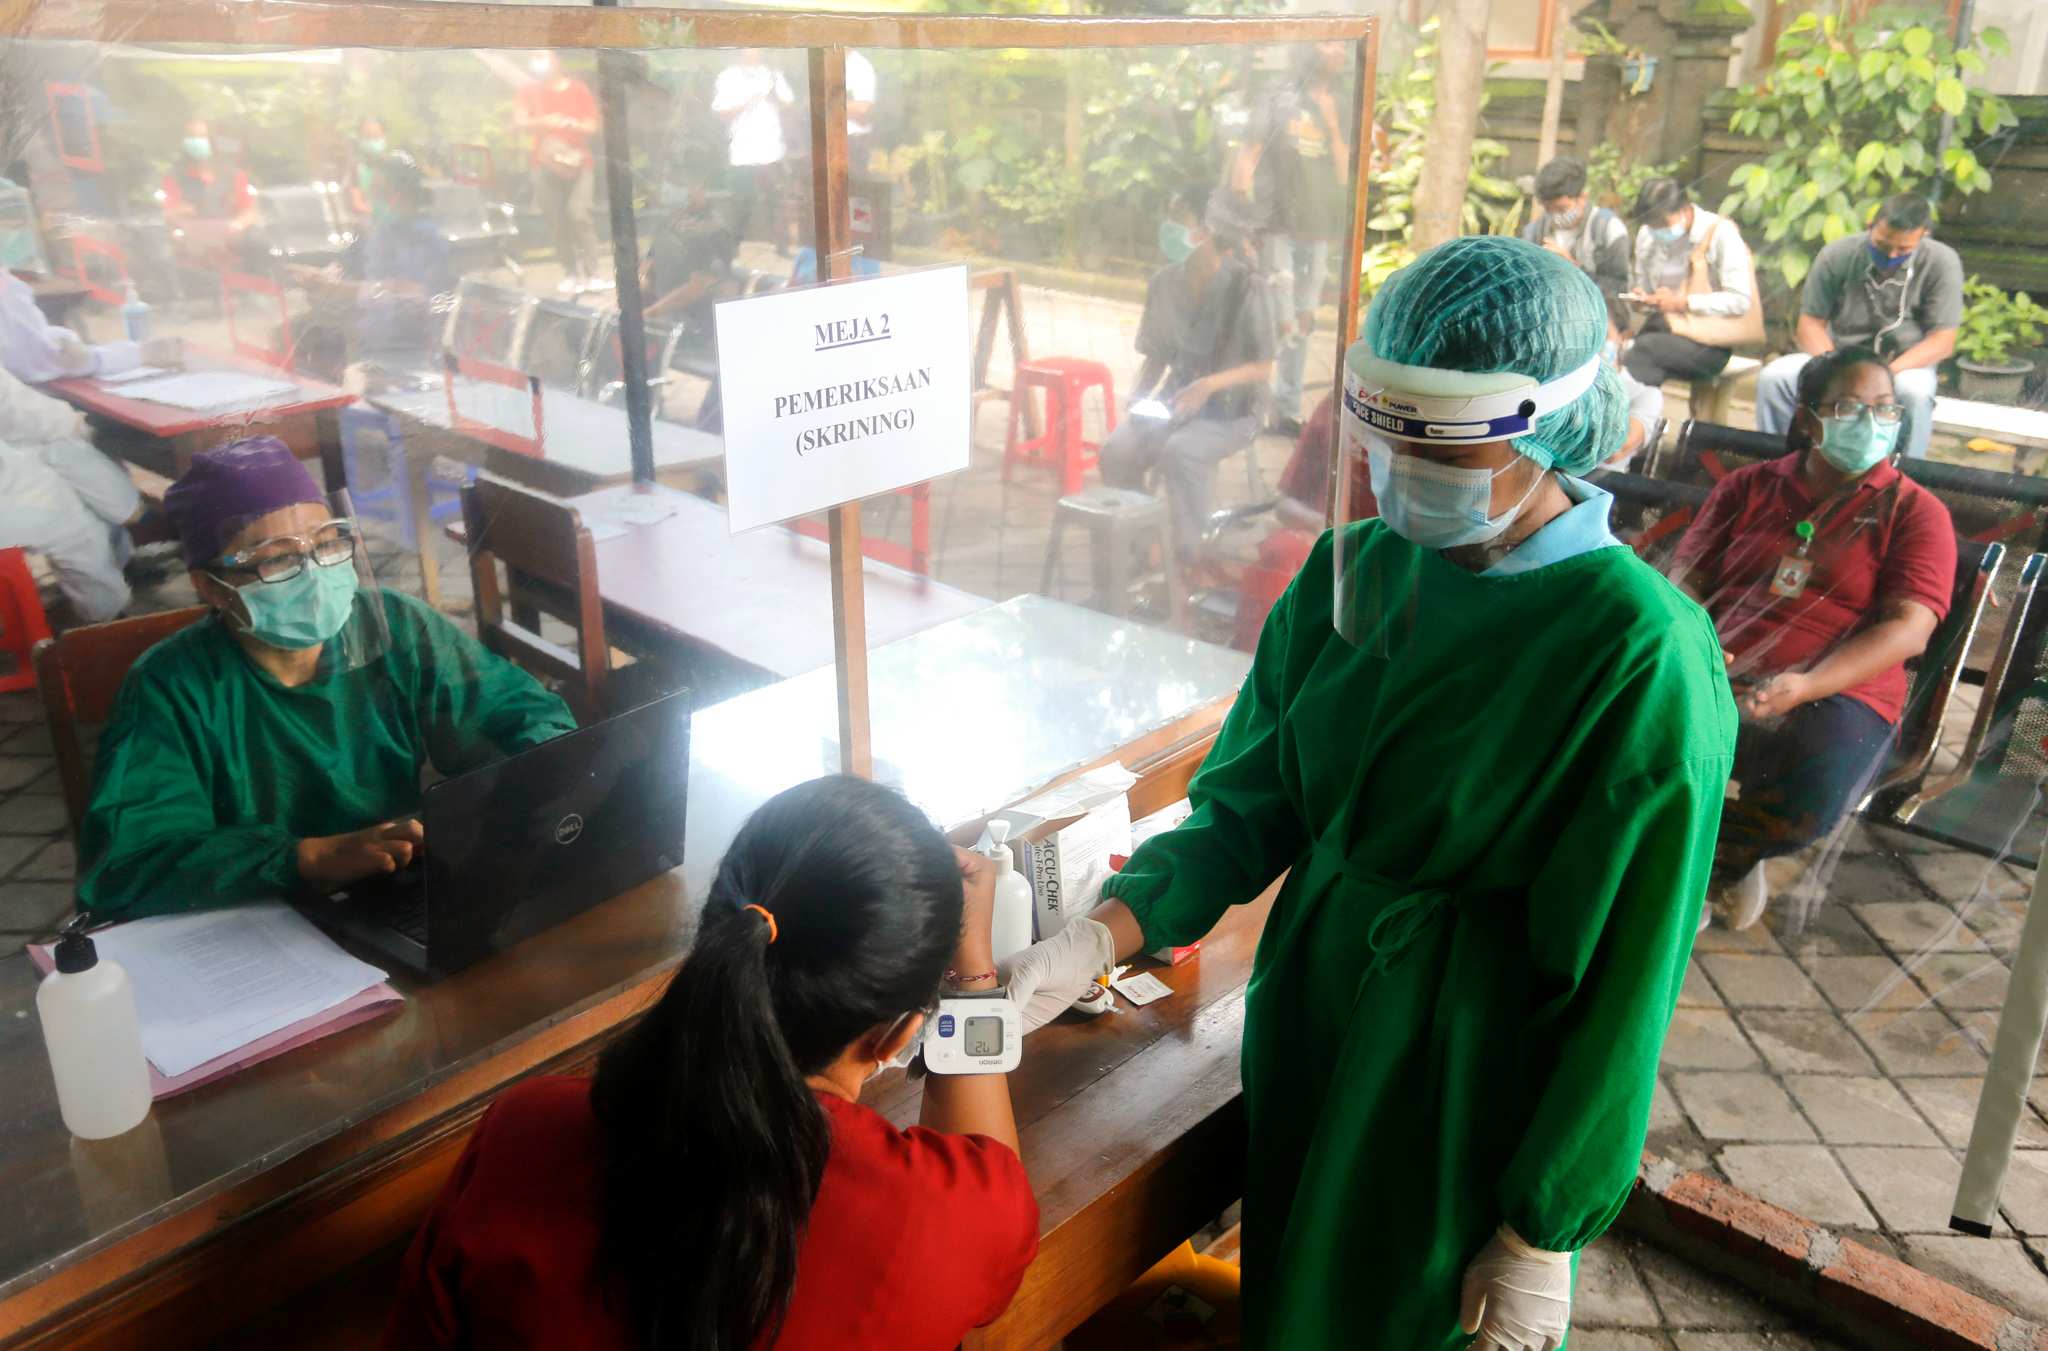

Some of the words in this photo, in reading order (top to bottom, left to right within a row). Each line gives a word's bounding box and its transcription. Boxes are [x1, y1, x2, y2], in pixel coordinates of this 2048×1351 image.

[814, 317, 874, 346] MEJA
[880, 313, 891, 334] 2
[774, 367, 932, 418] PEMERIKSAAN
[796, 408, 915, 457] (SKRINING)
[1371, 411, 1404, 432] SHIELD
[1042, 838, 1060, 911] ACCU-CHEK
